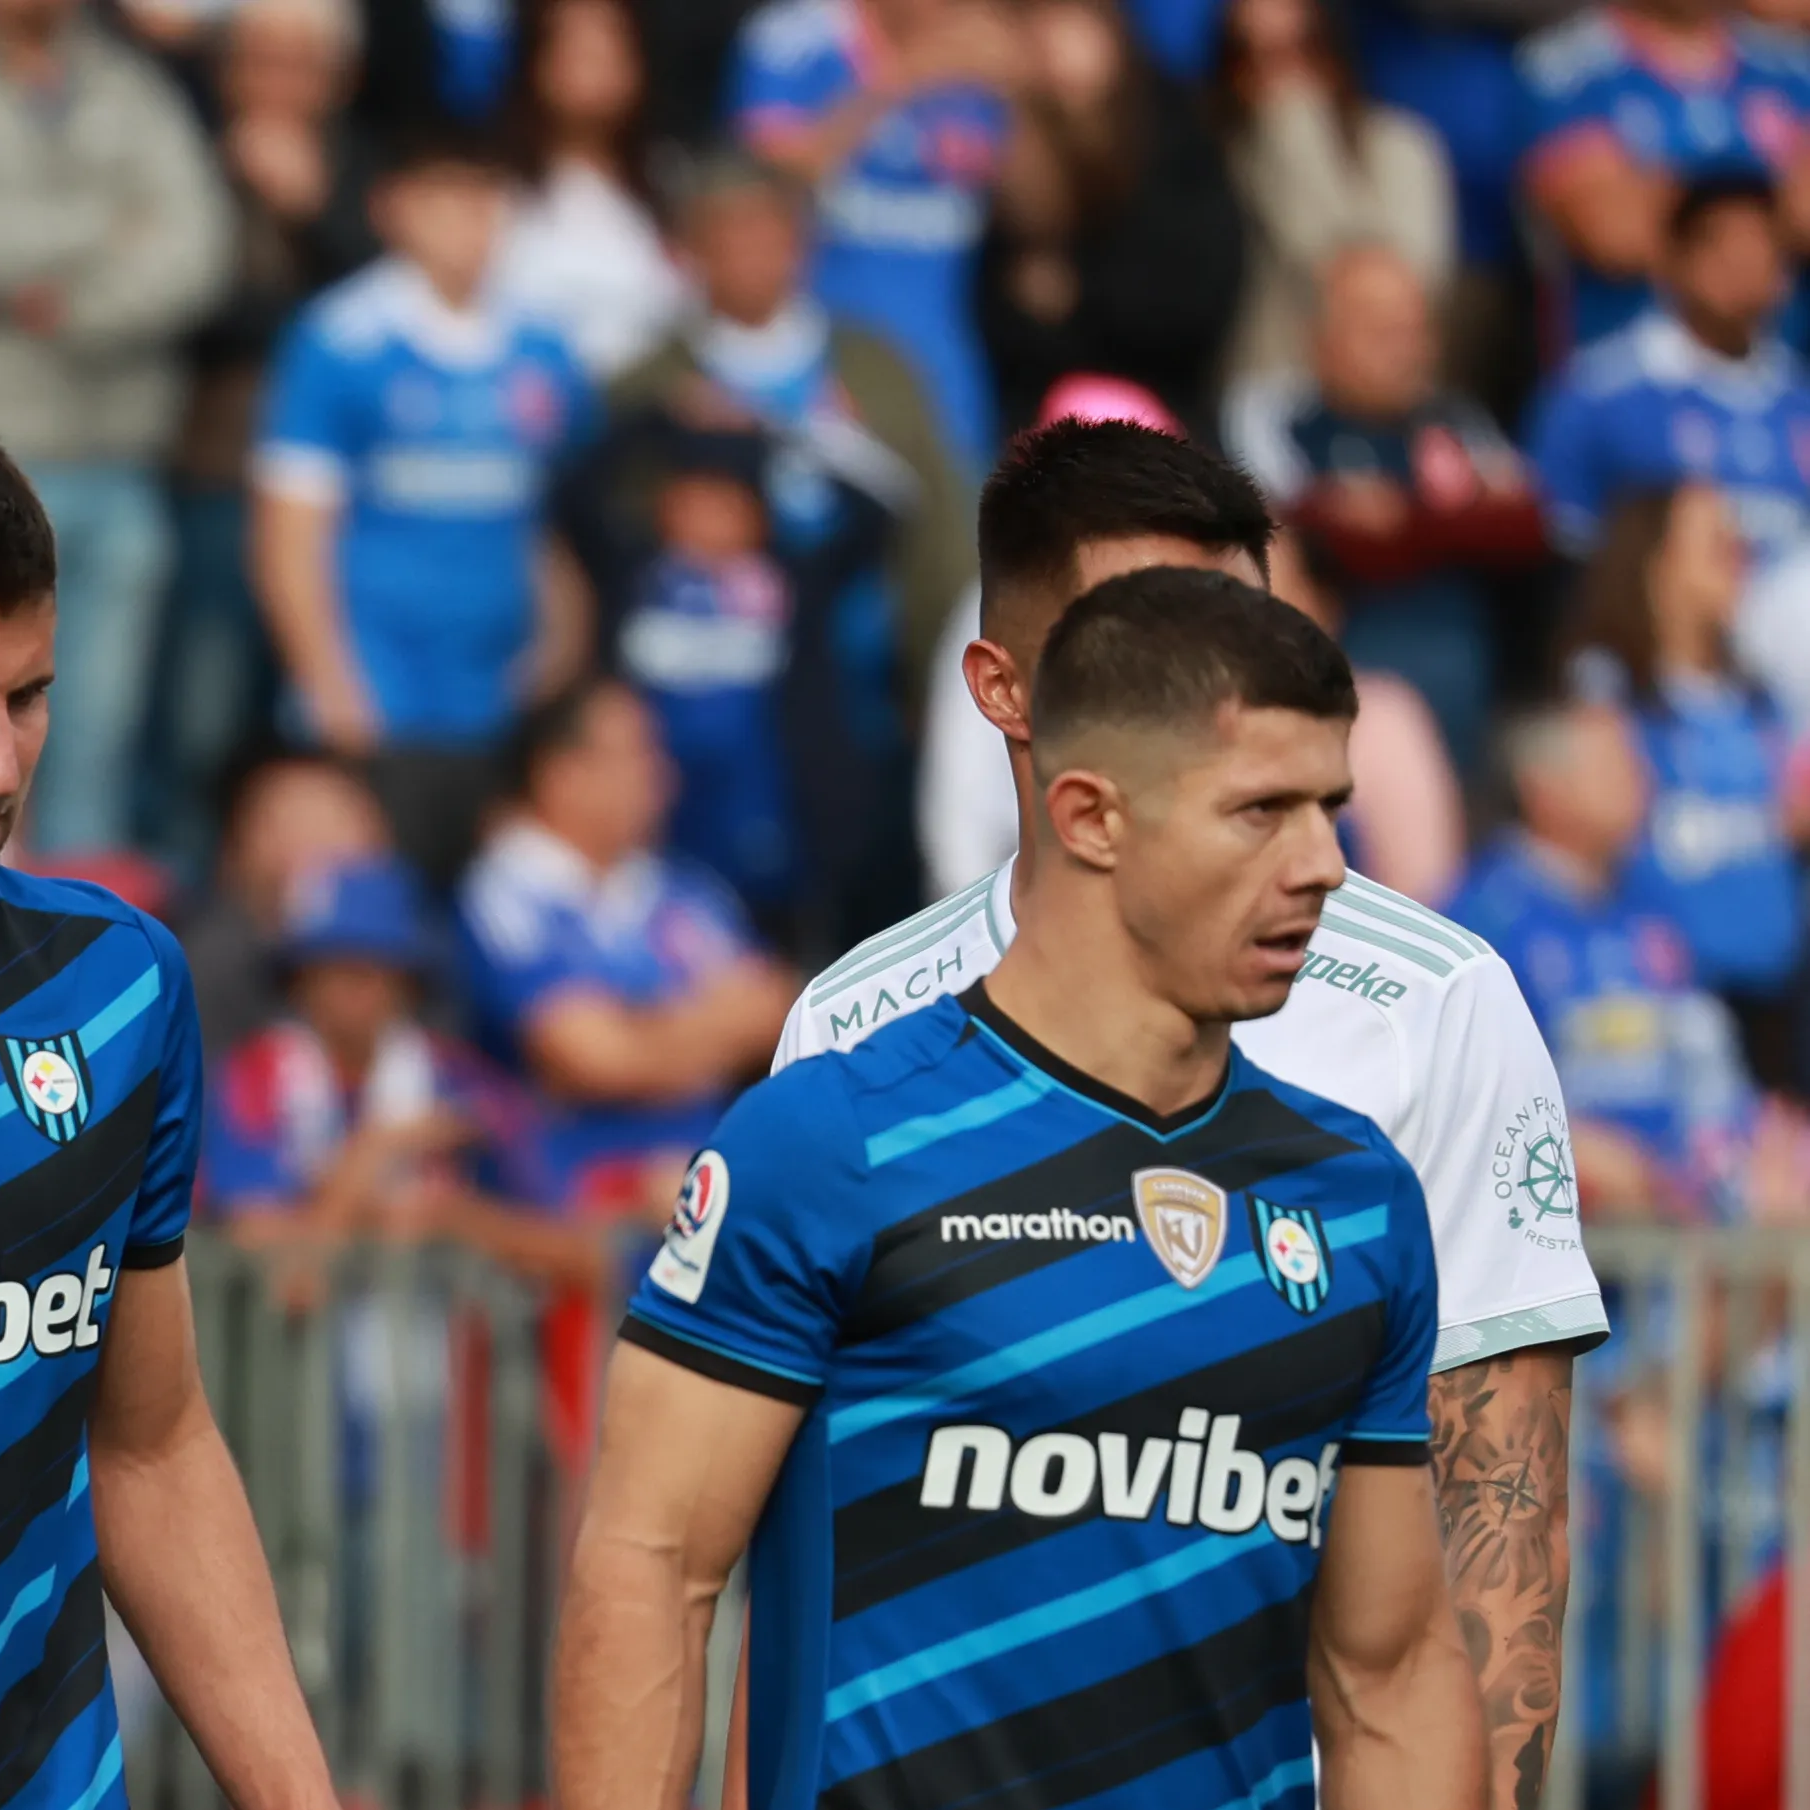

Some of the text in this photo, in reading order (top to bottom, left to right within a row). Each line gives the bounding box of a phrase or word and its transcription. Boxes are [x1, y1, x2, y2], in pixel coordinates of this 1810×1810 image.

[828, 945, 965, 1042] MACH
[1295, 949, 1408, 1008] peke
[942, 1207, 1135, 1242] marathon
